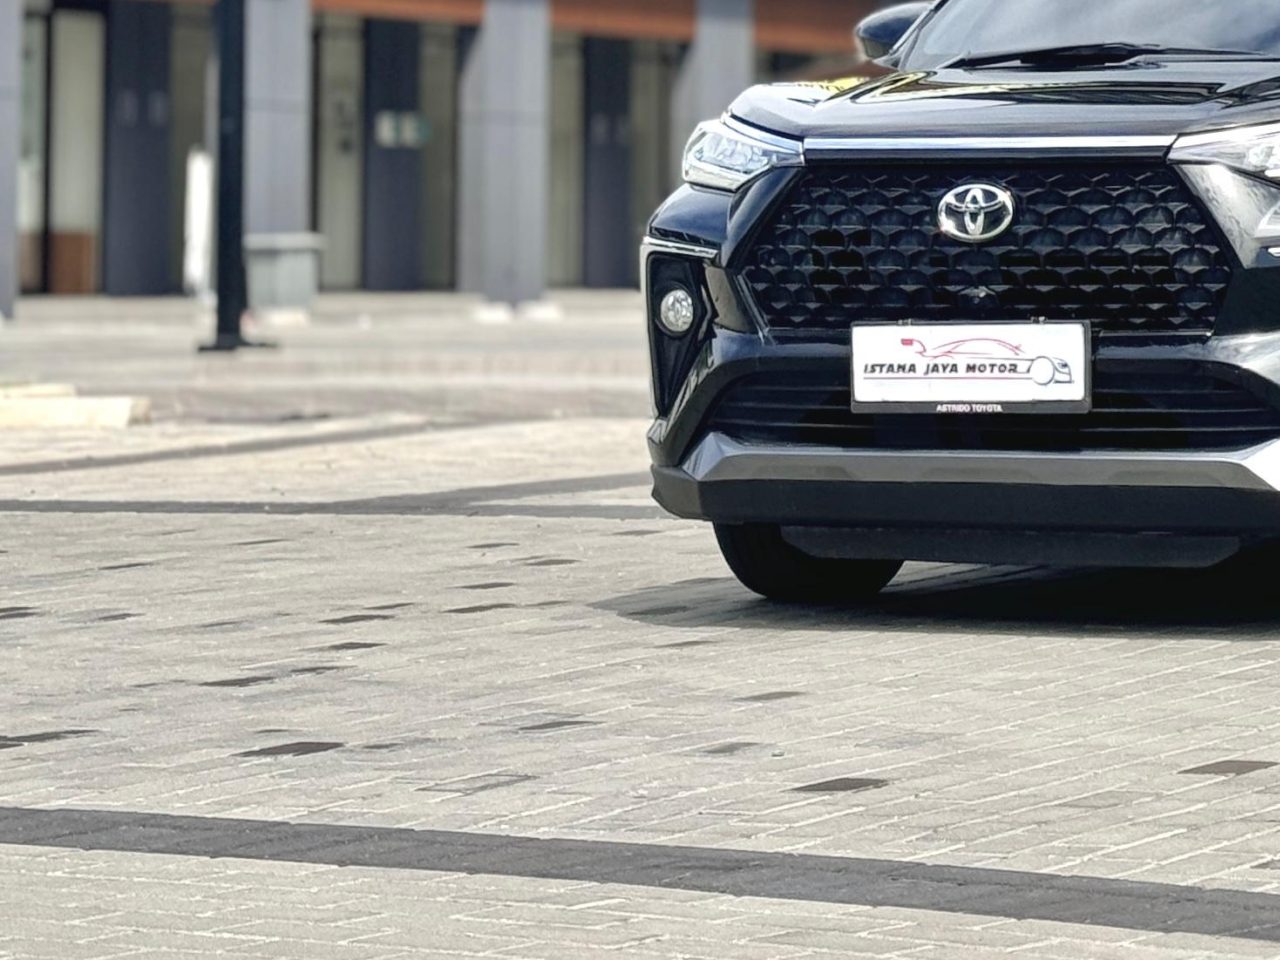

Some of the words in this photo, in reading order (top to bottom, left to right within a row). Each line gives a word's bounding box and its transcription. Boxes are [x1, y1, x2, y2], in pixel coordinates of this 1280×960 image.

[864, 363, 917, 375] ISTANA
[923, 363, 959, 376] JAYA
[966, 363, 1018, 374] MOTOR
[972, 404, 1003, 413] TOYOTA
